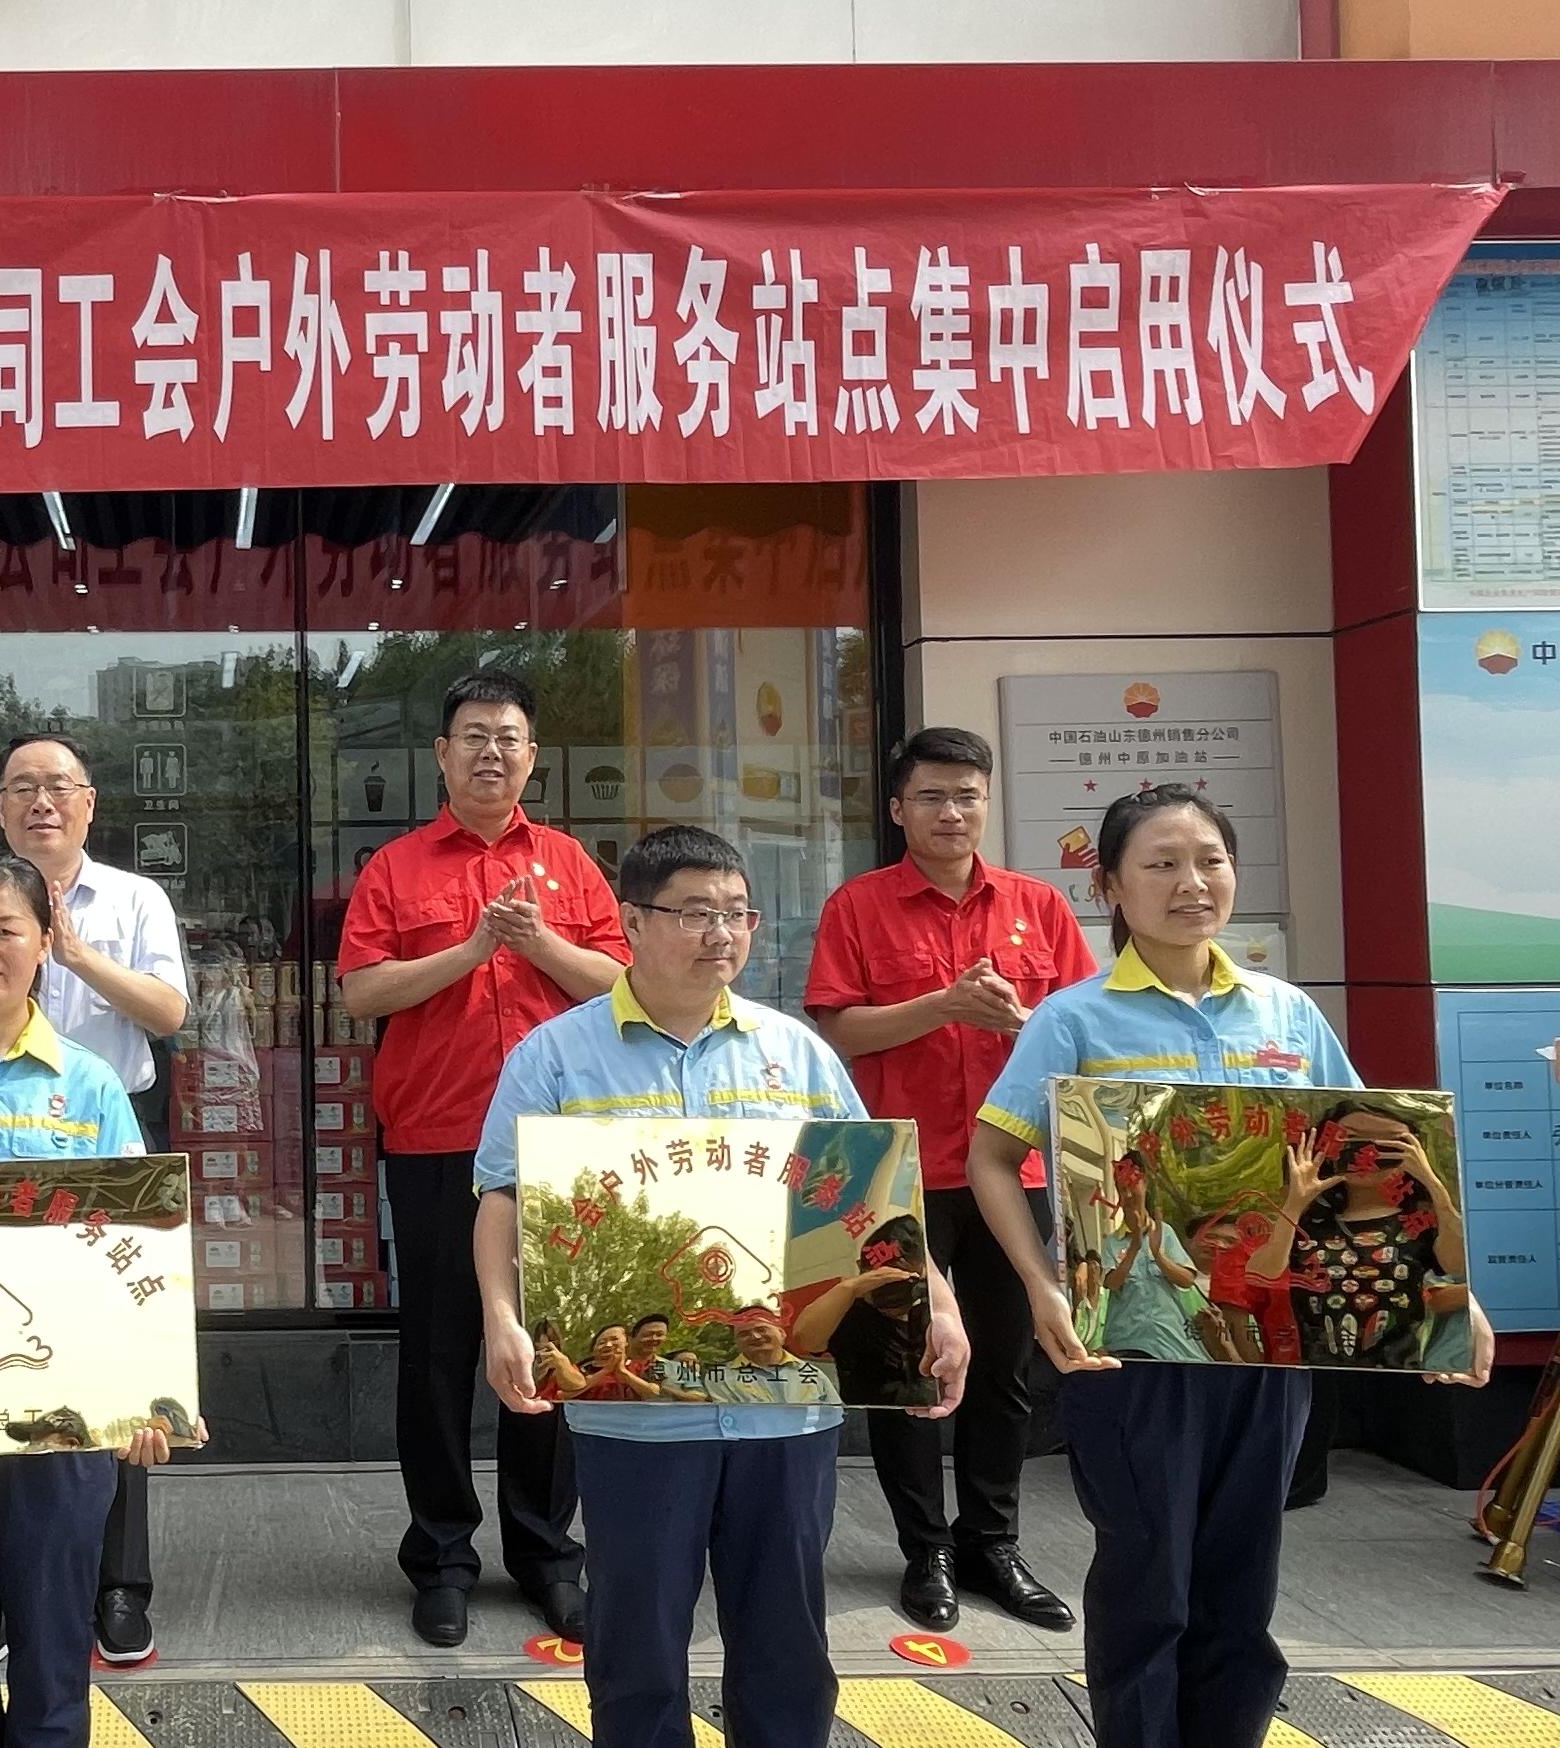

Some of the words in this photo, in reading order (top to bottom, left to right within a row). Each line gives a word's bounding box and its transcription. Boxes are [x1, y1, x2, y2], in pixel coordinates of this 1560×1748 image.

[1049, 727, 1240, 745] 中国石油山东德州销售分公司
